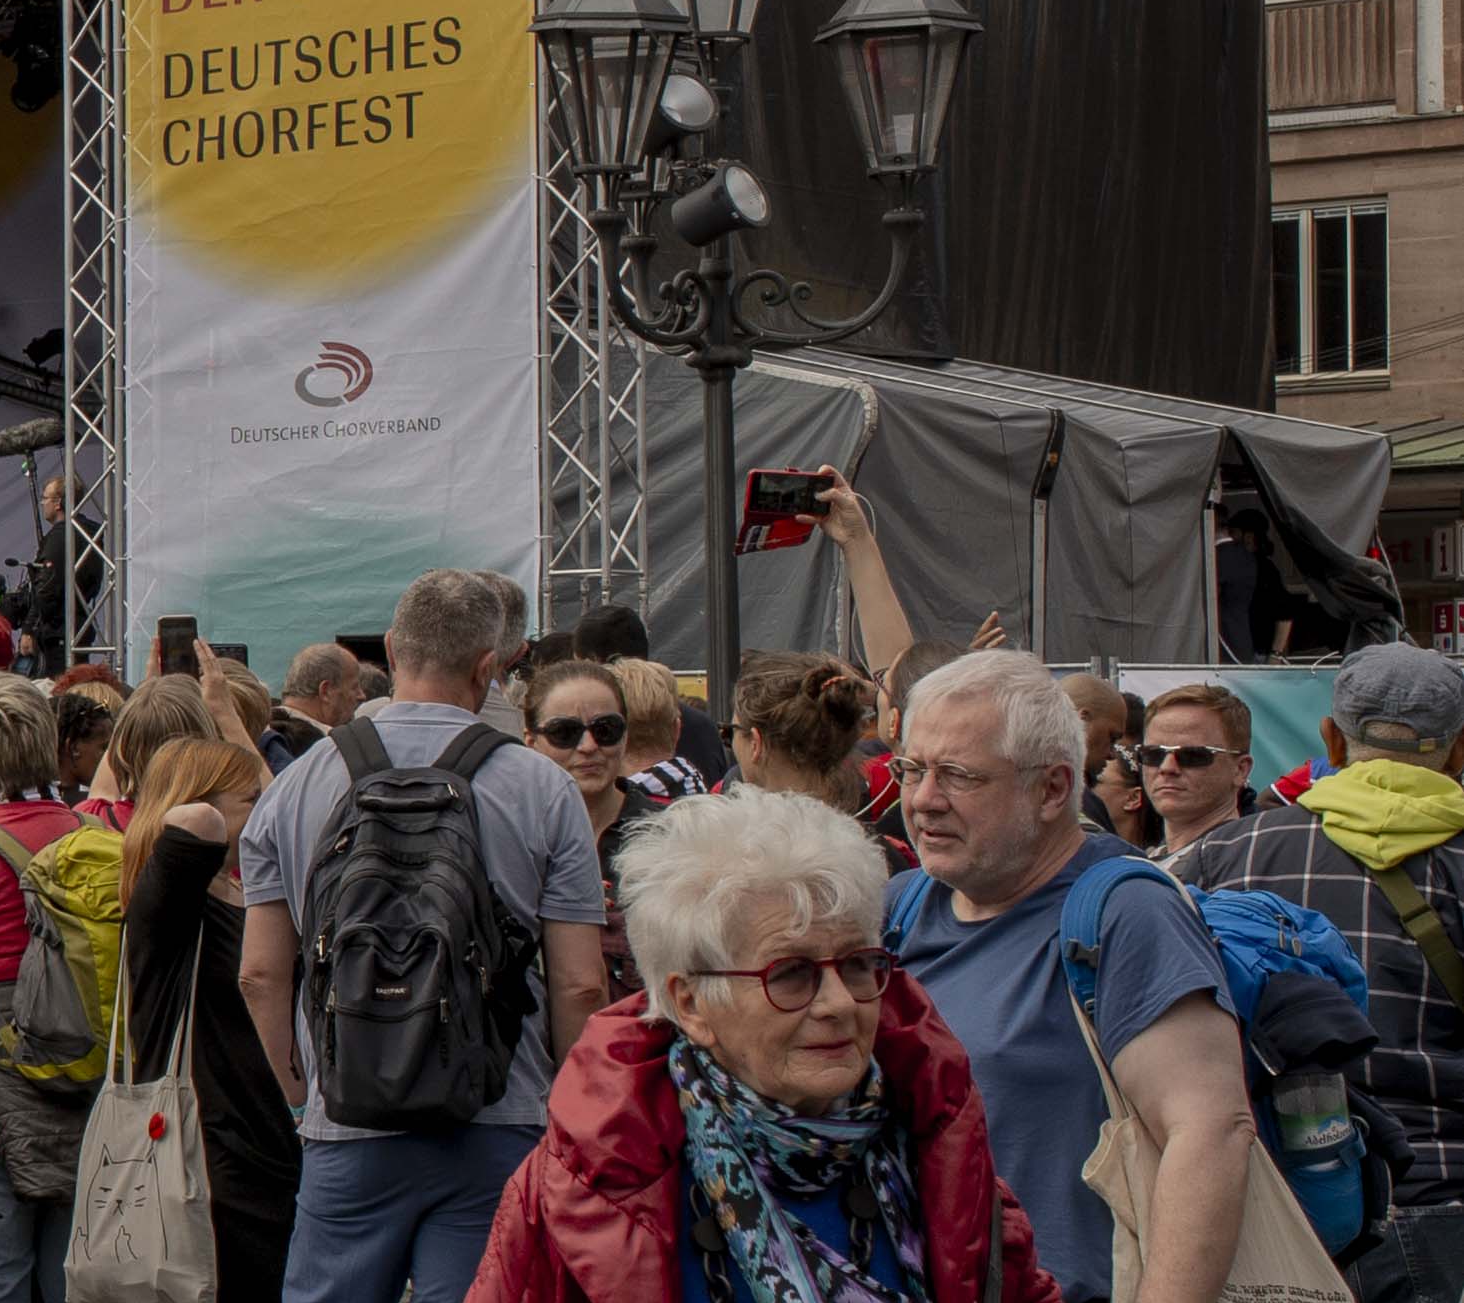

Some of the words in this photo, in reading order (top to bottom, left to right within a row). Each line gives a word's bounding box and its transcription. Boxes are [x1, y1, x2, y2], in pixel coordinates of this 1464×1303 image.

[163, 15, 463, 100] DEUTSCHES
[163, 90, 424, 167] CHORFEST
[231, 425, 319, 444] DEUTSCHER
[323, 416, 442, 438] CHORVERBAND
